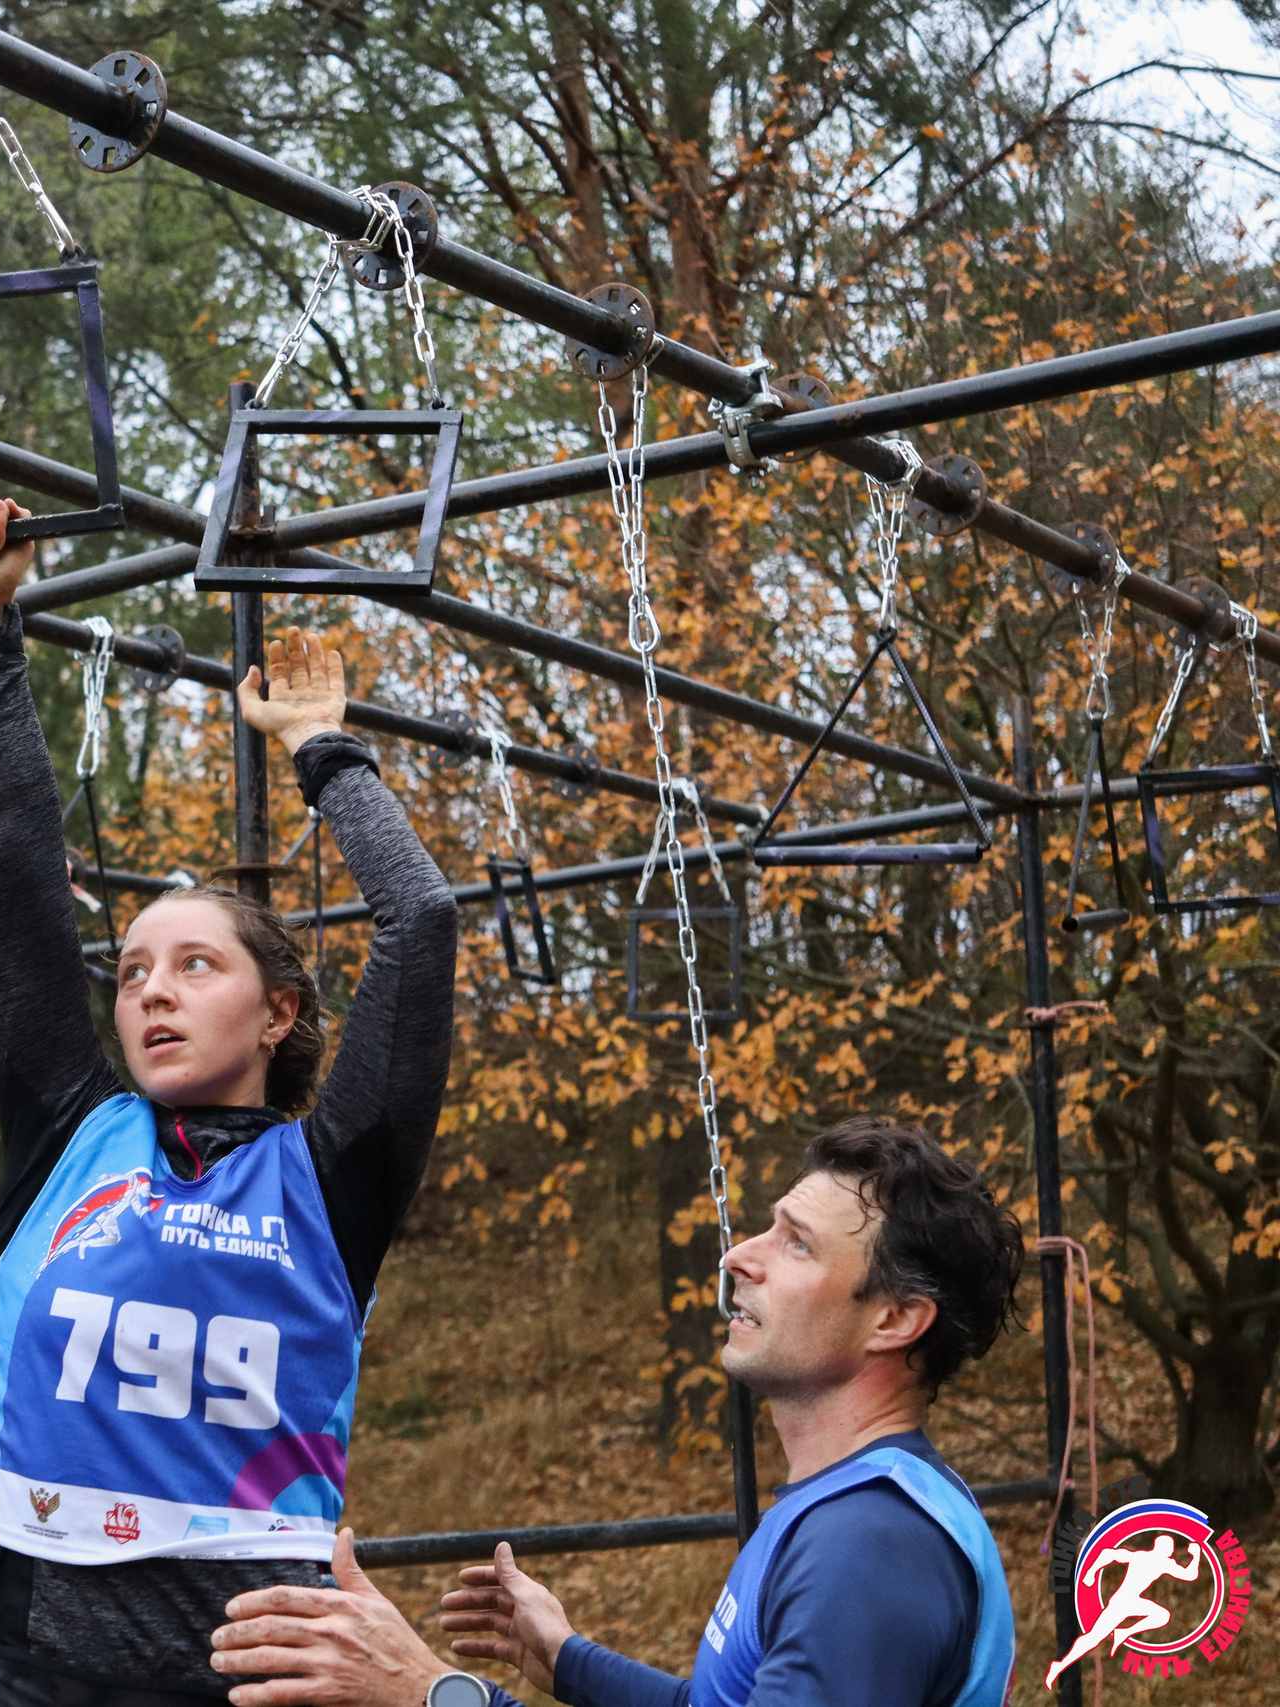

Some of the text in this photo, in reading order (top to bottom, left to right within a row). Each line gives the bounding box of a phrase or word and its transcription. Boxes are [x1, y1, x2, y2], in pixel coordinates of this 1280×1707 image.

[164, 1203, 251, 1236] ГОНКА
[160, 1224, 210, 1250] ПУТЬ
[49, 1286, 281, 1430] 799
